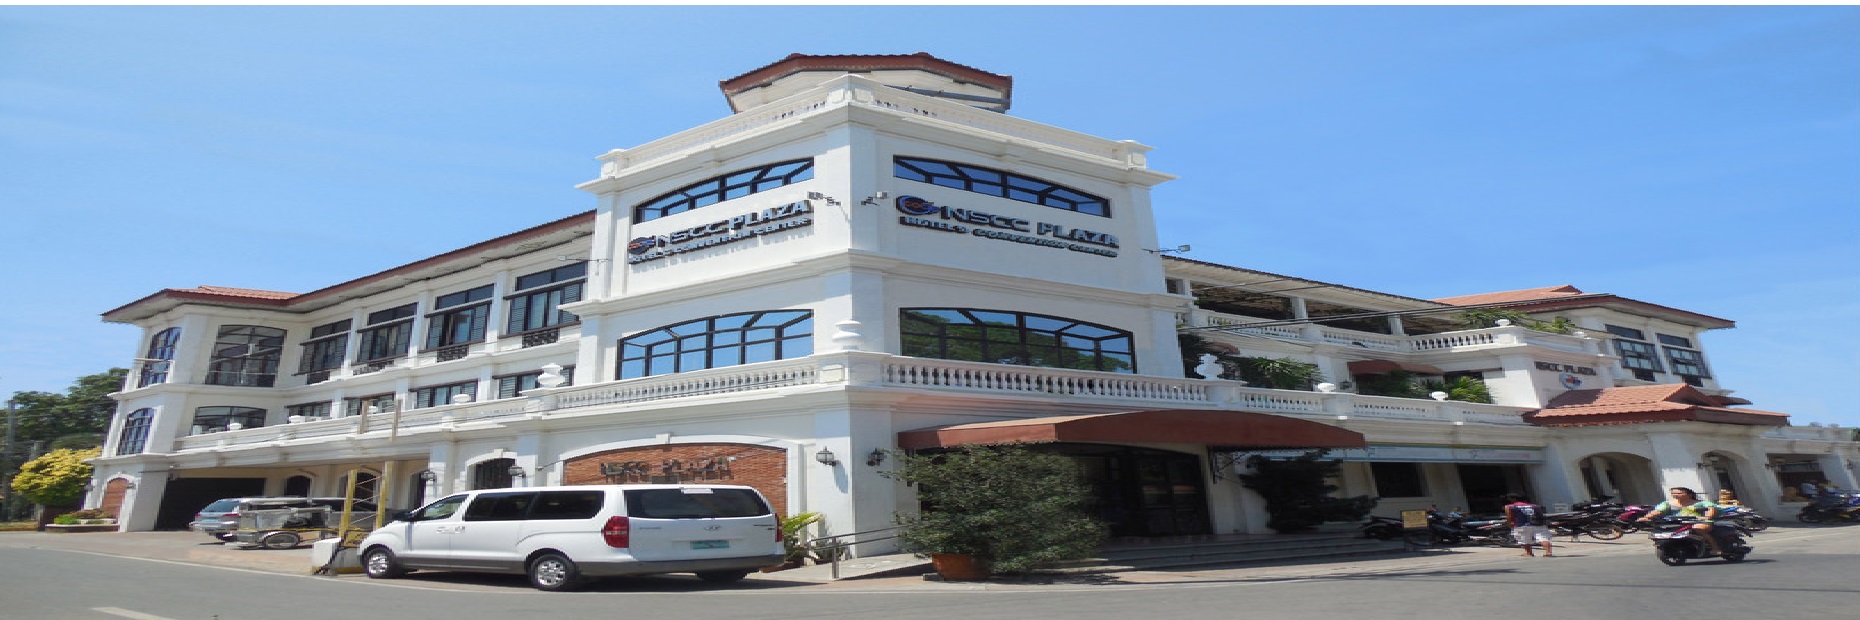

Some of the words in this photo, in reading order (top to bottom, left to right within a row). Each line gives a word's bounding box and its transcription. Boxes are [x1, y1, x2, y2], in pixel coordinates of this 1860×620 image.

[655, 219, 729, 247] NSCC
[729, 199, 814, 231] PLAZA
[940, 206, 1030, 232] NSCC
[1036, 222, 1119, 249] PLAZA
